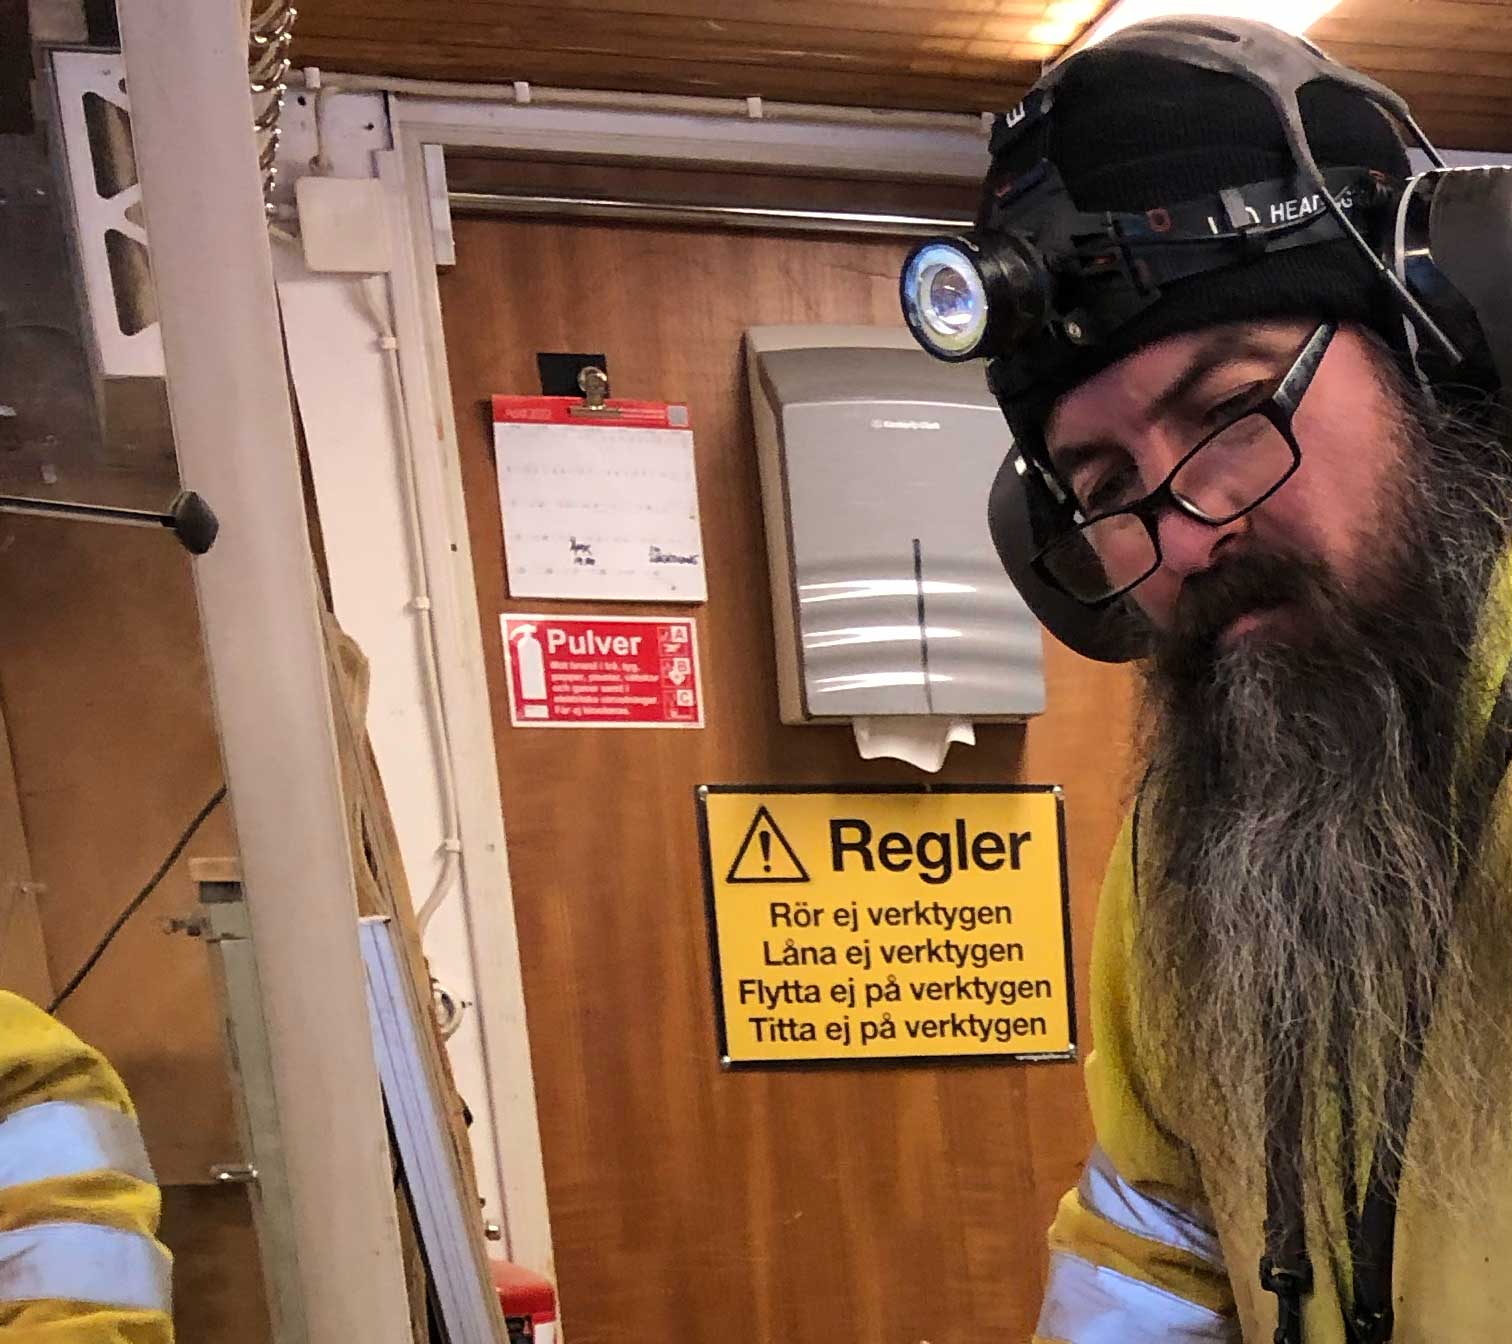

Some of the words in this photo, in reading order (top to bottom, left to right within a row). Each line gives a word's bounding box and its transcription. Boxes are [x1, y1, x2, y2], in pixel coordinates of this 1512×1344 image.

[546, 628, 643, 656] Pulver
[829, 818, 1032, 885] Regler
[769, 902, 825, 928] Rör
[833, 902, 860, 932] ej
[867, 900, 1013, 932] verktygen
[762, 938, 837, 967] Låna
[845, 939, 872, 970] ej
[880, 938, 1024, 970] verktygen
[738, 978, 821, 1010] Flytta
[830, 978, 856, 1008] ej
[865, 974, 901, 1007] på
[909, 974, 1053, 1006] verktygen
[748, 1016, 817, 1043] Titta
[825, 1016, 851, 1046] ej
[861, 1012, 896, 1045] på
[905, 1012, 1047, 1043] verktygen
